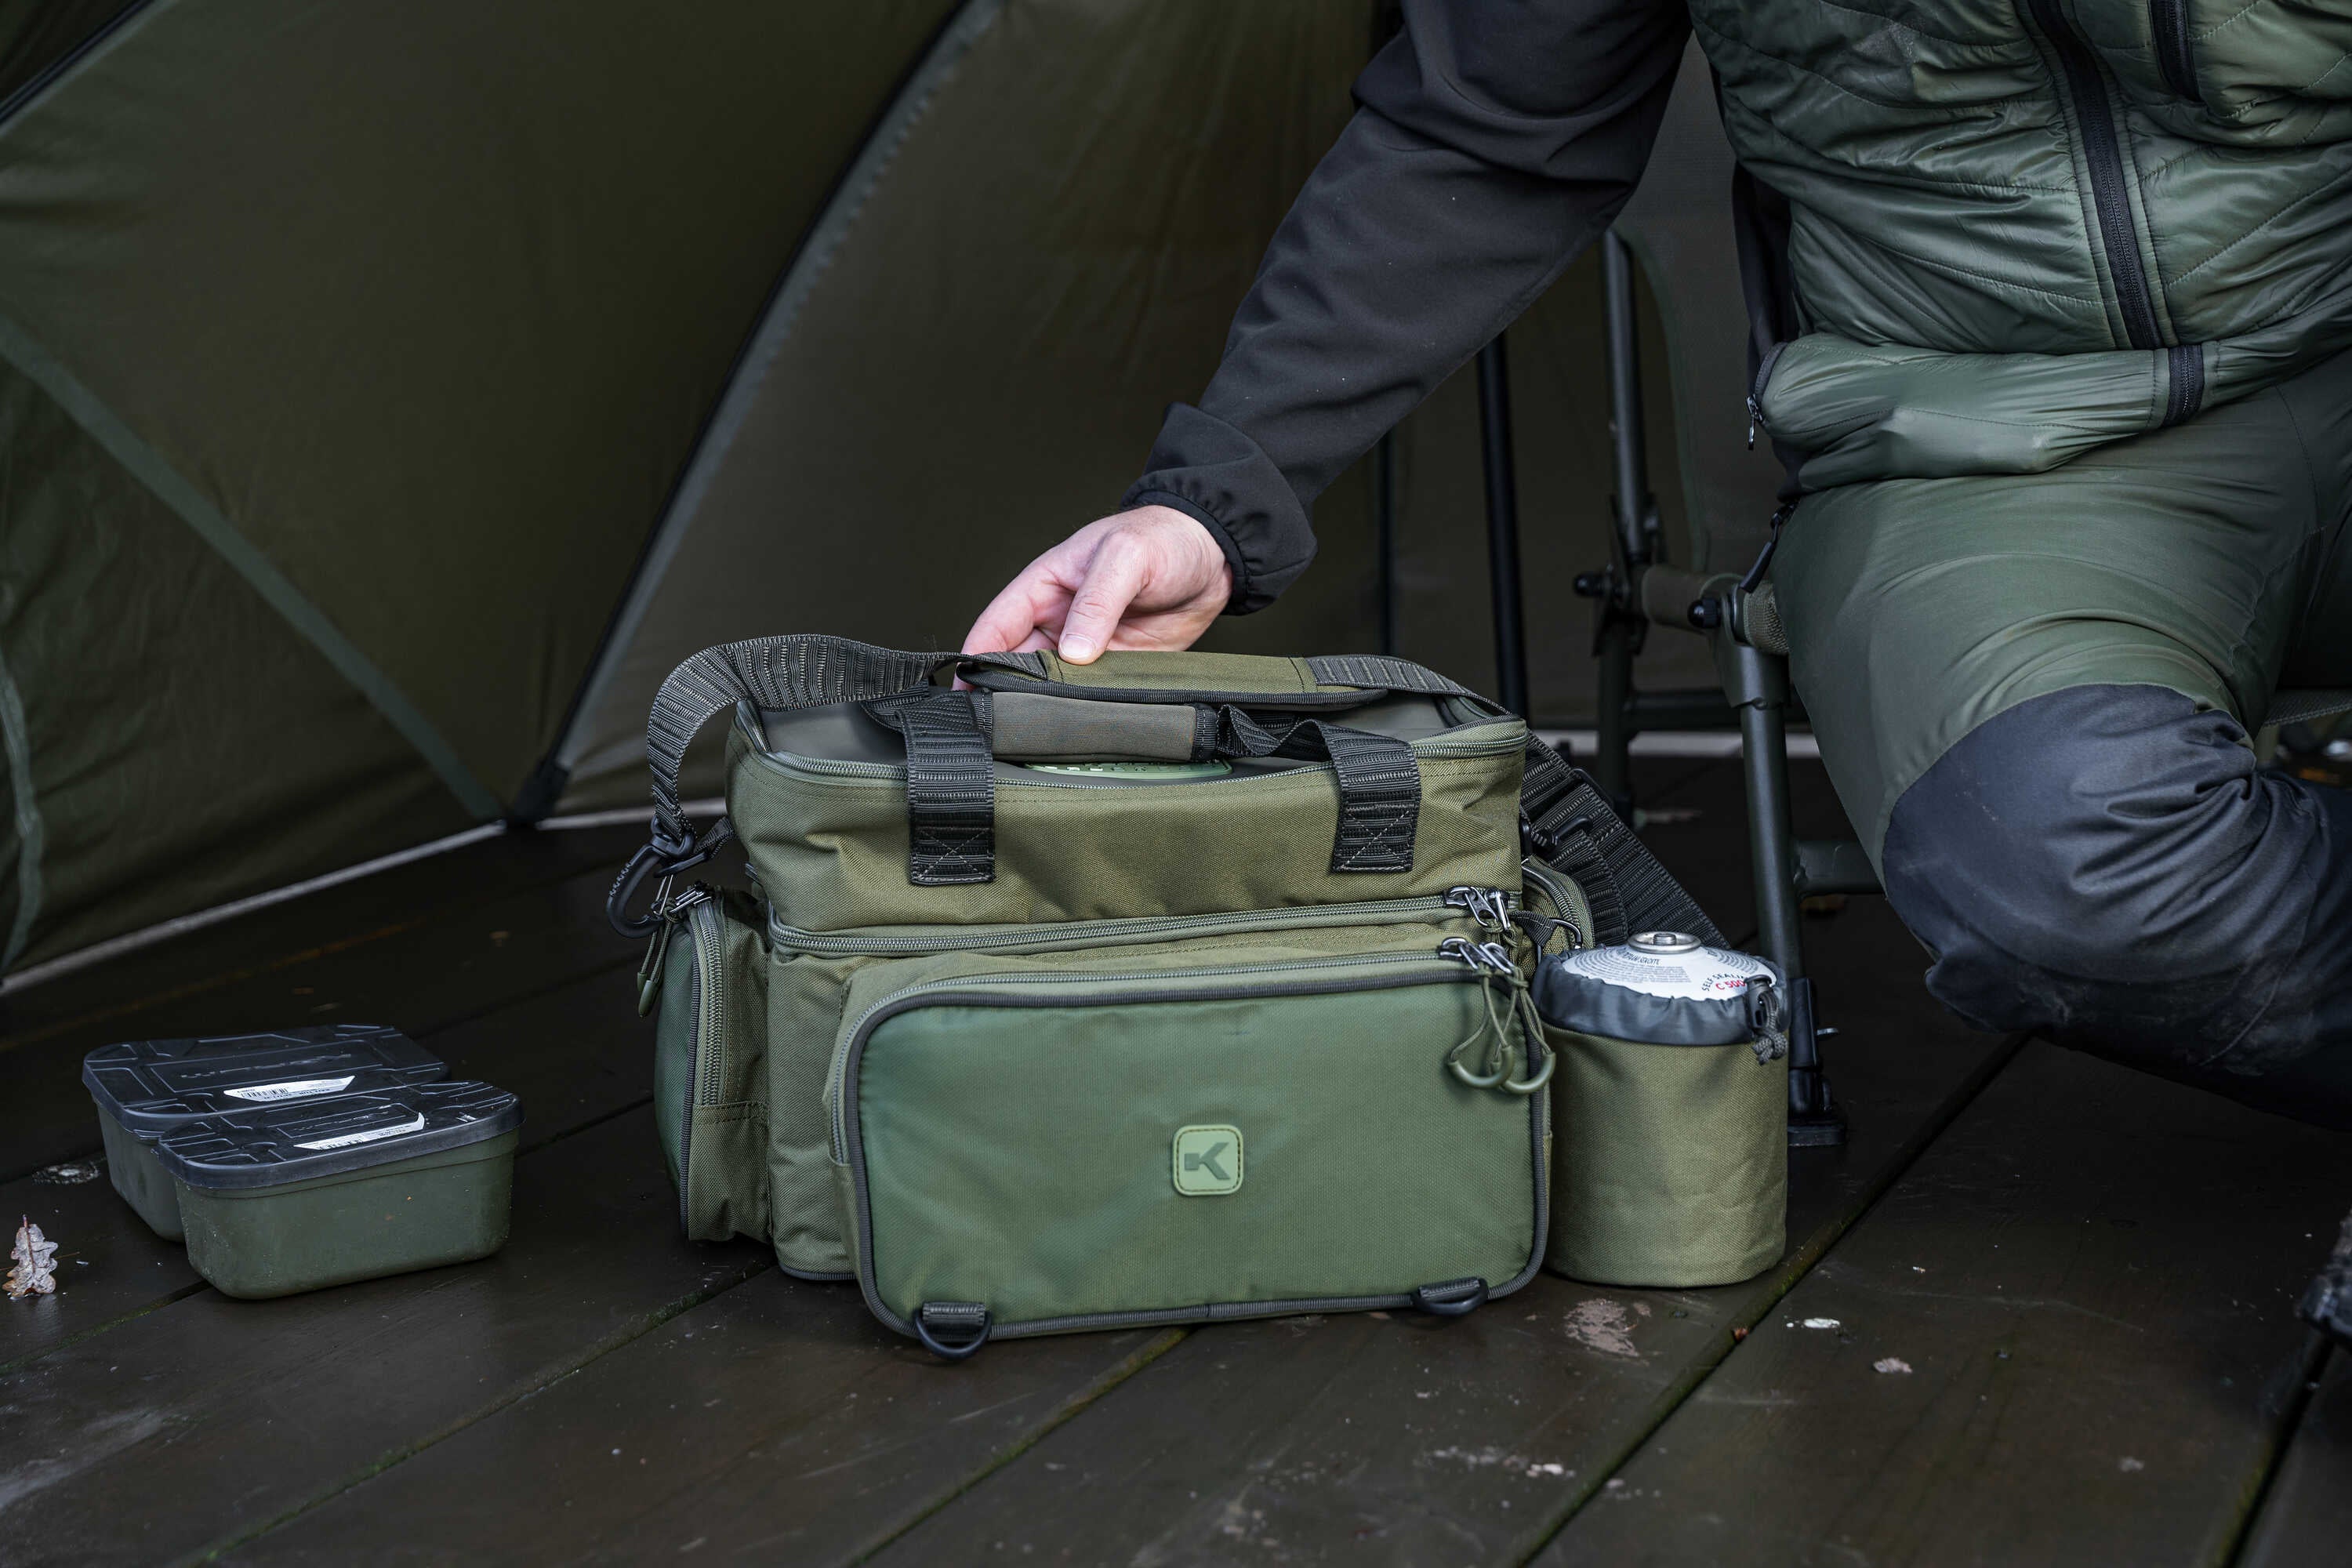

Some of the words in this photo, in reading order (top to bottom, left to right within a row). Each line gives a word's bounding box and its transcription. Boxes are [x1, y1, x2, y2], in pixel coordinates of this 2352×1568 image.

[1701, 978, 1714, 992] SELF
[1724, 979, 1746, 988] 500
[1184, 1142, 1231, 1180] K
